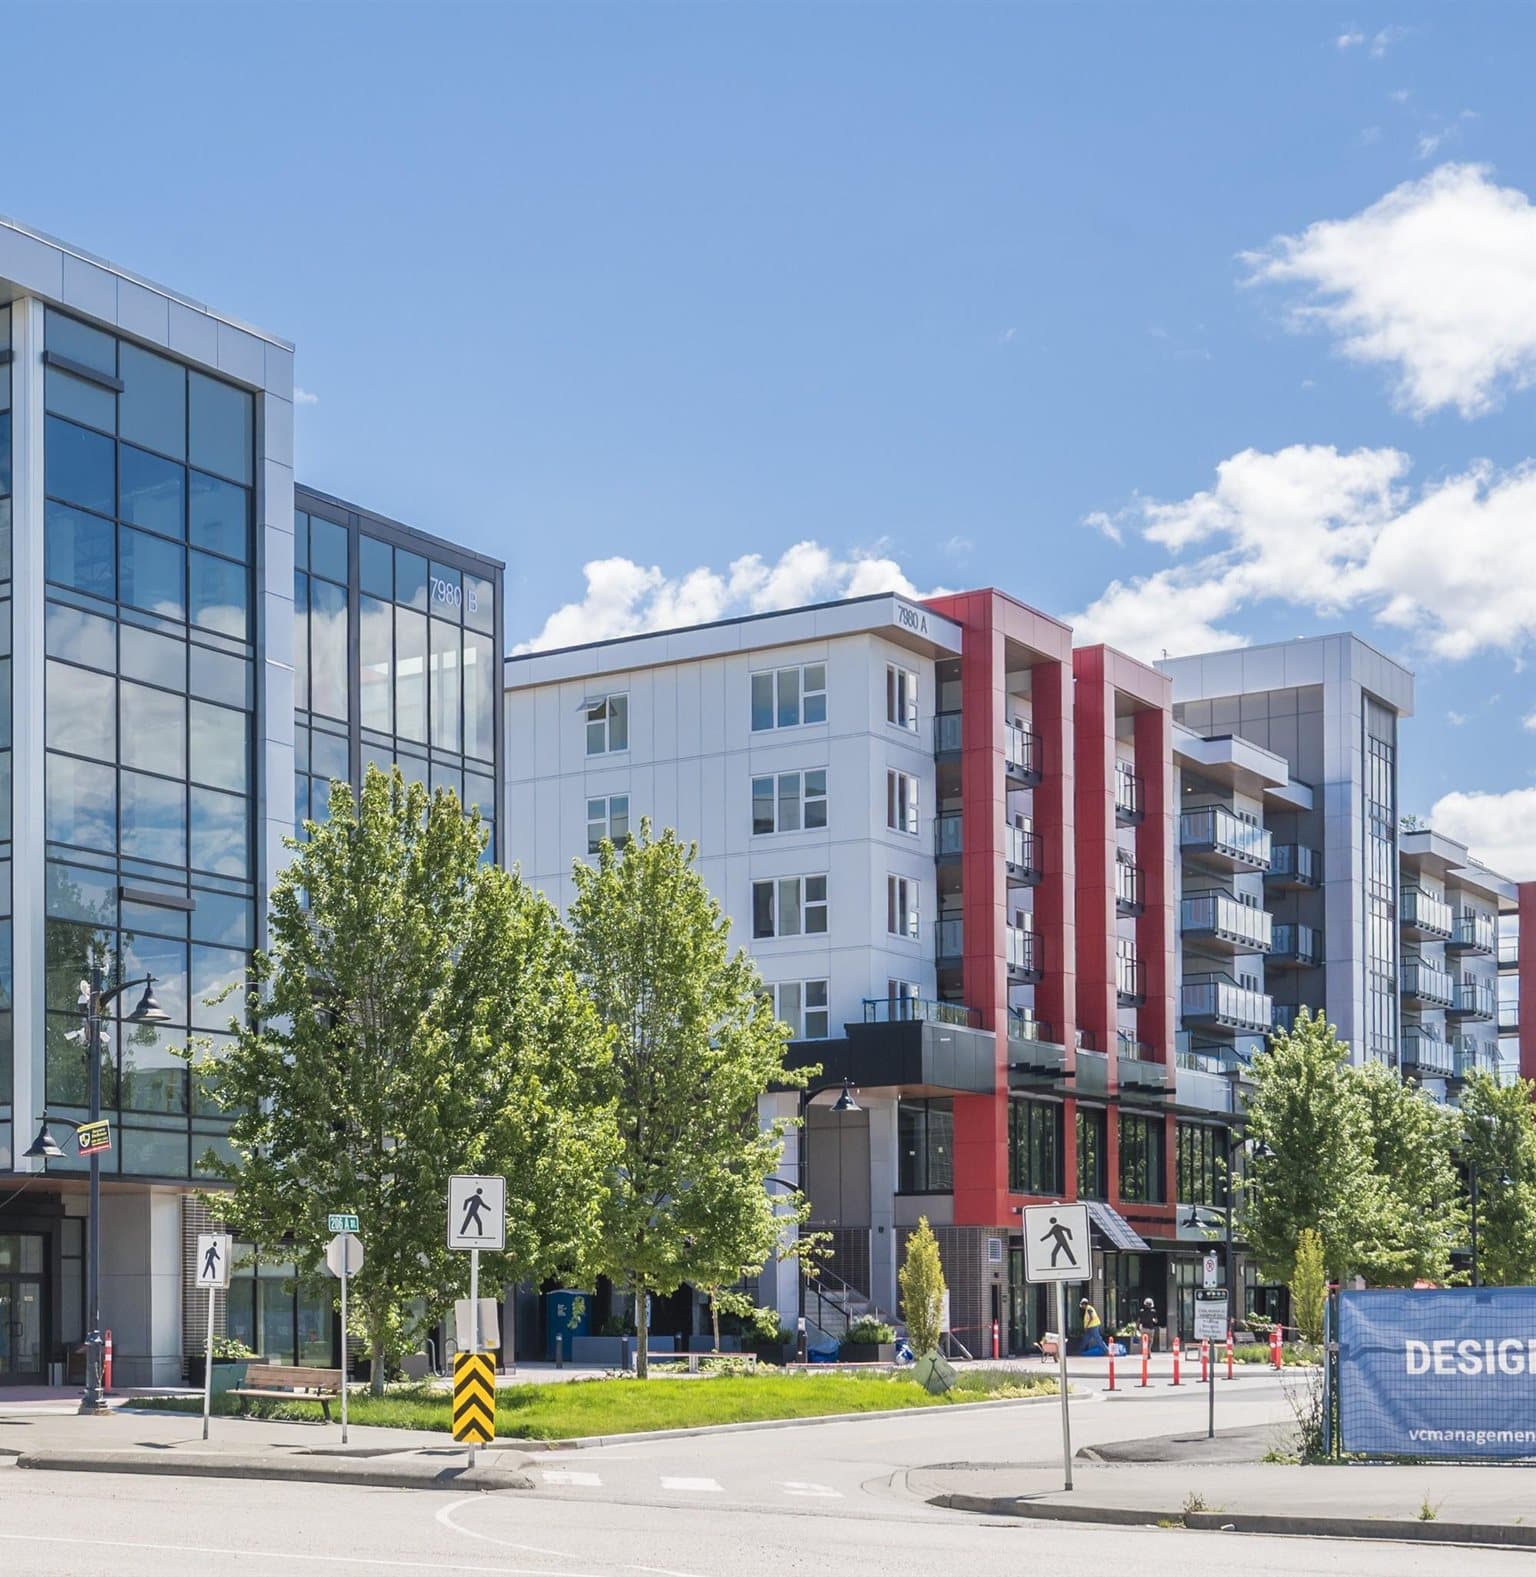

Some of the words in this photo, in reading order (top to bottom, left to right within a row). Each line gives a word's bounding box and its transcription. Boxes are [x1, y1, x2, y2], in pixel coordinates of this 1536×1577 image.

[430, 576, 461, 608] 7980
[467, 590, 478, 612] B
[898, 605, 919, 630] 7980
[921, 615, 928, 634] A
[1409, 1429, 1536, 1445] vcmanagemen
